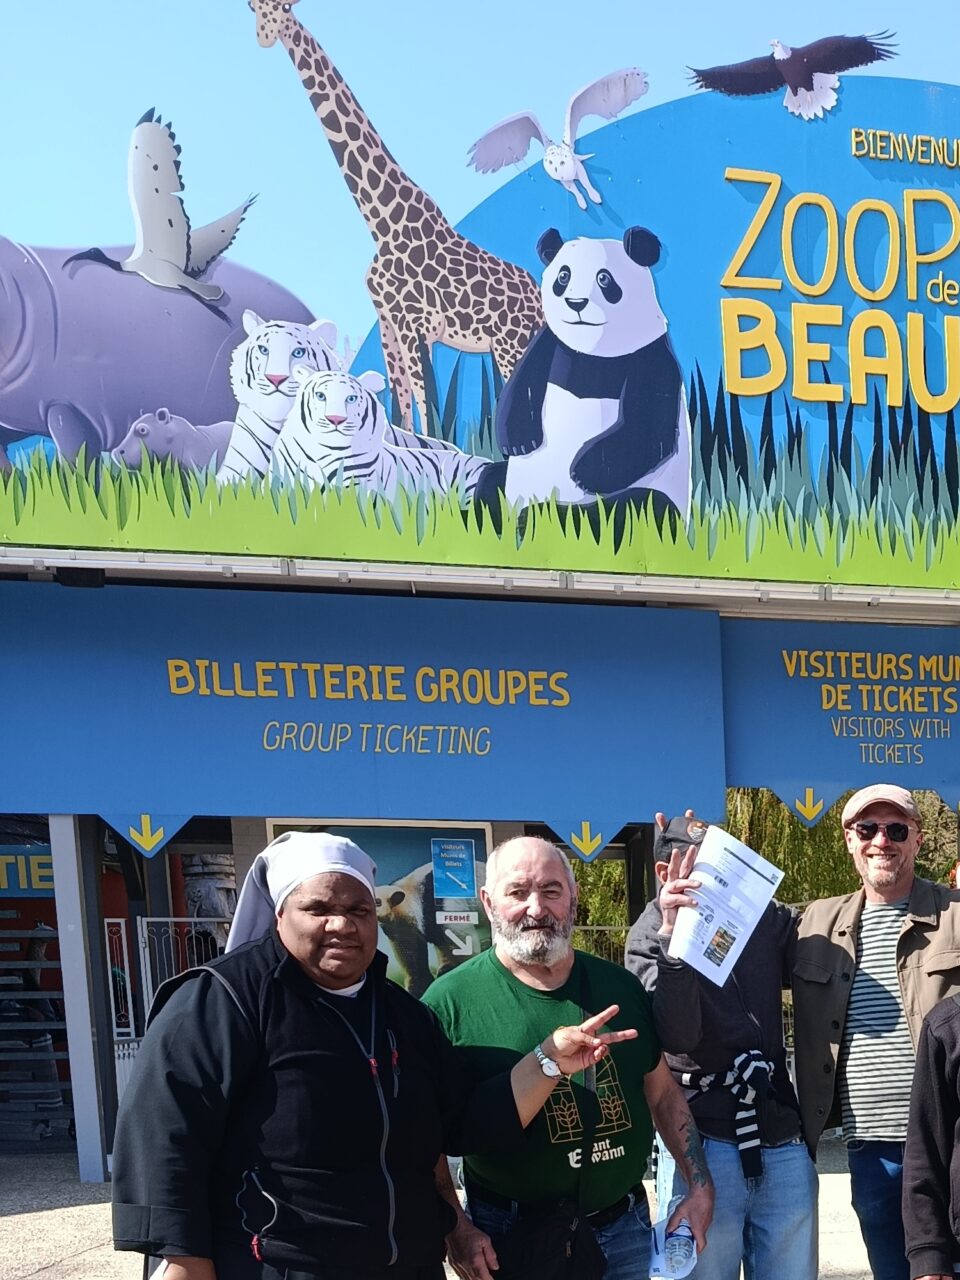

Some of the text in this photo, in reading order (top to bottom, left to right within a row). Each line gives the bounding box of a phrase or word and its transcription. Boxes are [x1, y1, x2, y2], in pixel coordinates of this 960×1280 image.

[926, 270, 960, 305] de
[782, 650, 914, 681] VISITEURS
[167, 659, 571, 707] BILLETTERIE GROUPES
[821, 684, 958, 713] DE TICKETS
[262, 721, 492, 756] GROUP TICKETING
[831, 716, 951, 739] VISITORS WITH
[859, 743, 924, 764] TICKETS
[444, 914, 470, 922] FERMÉ
